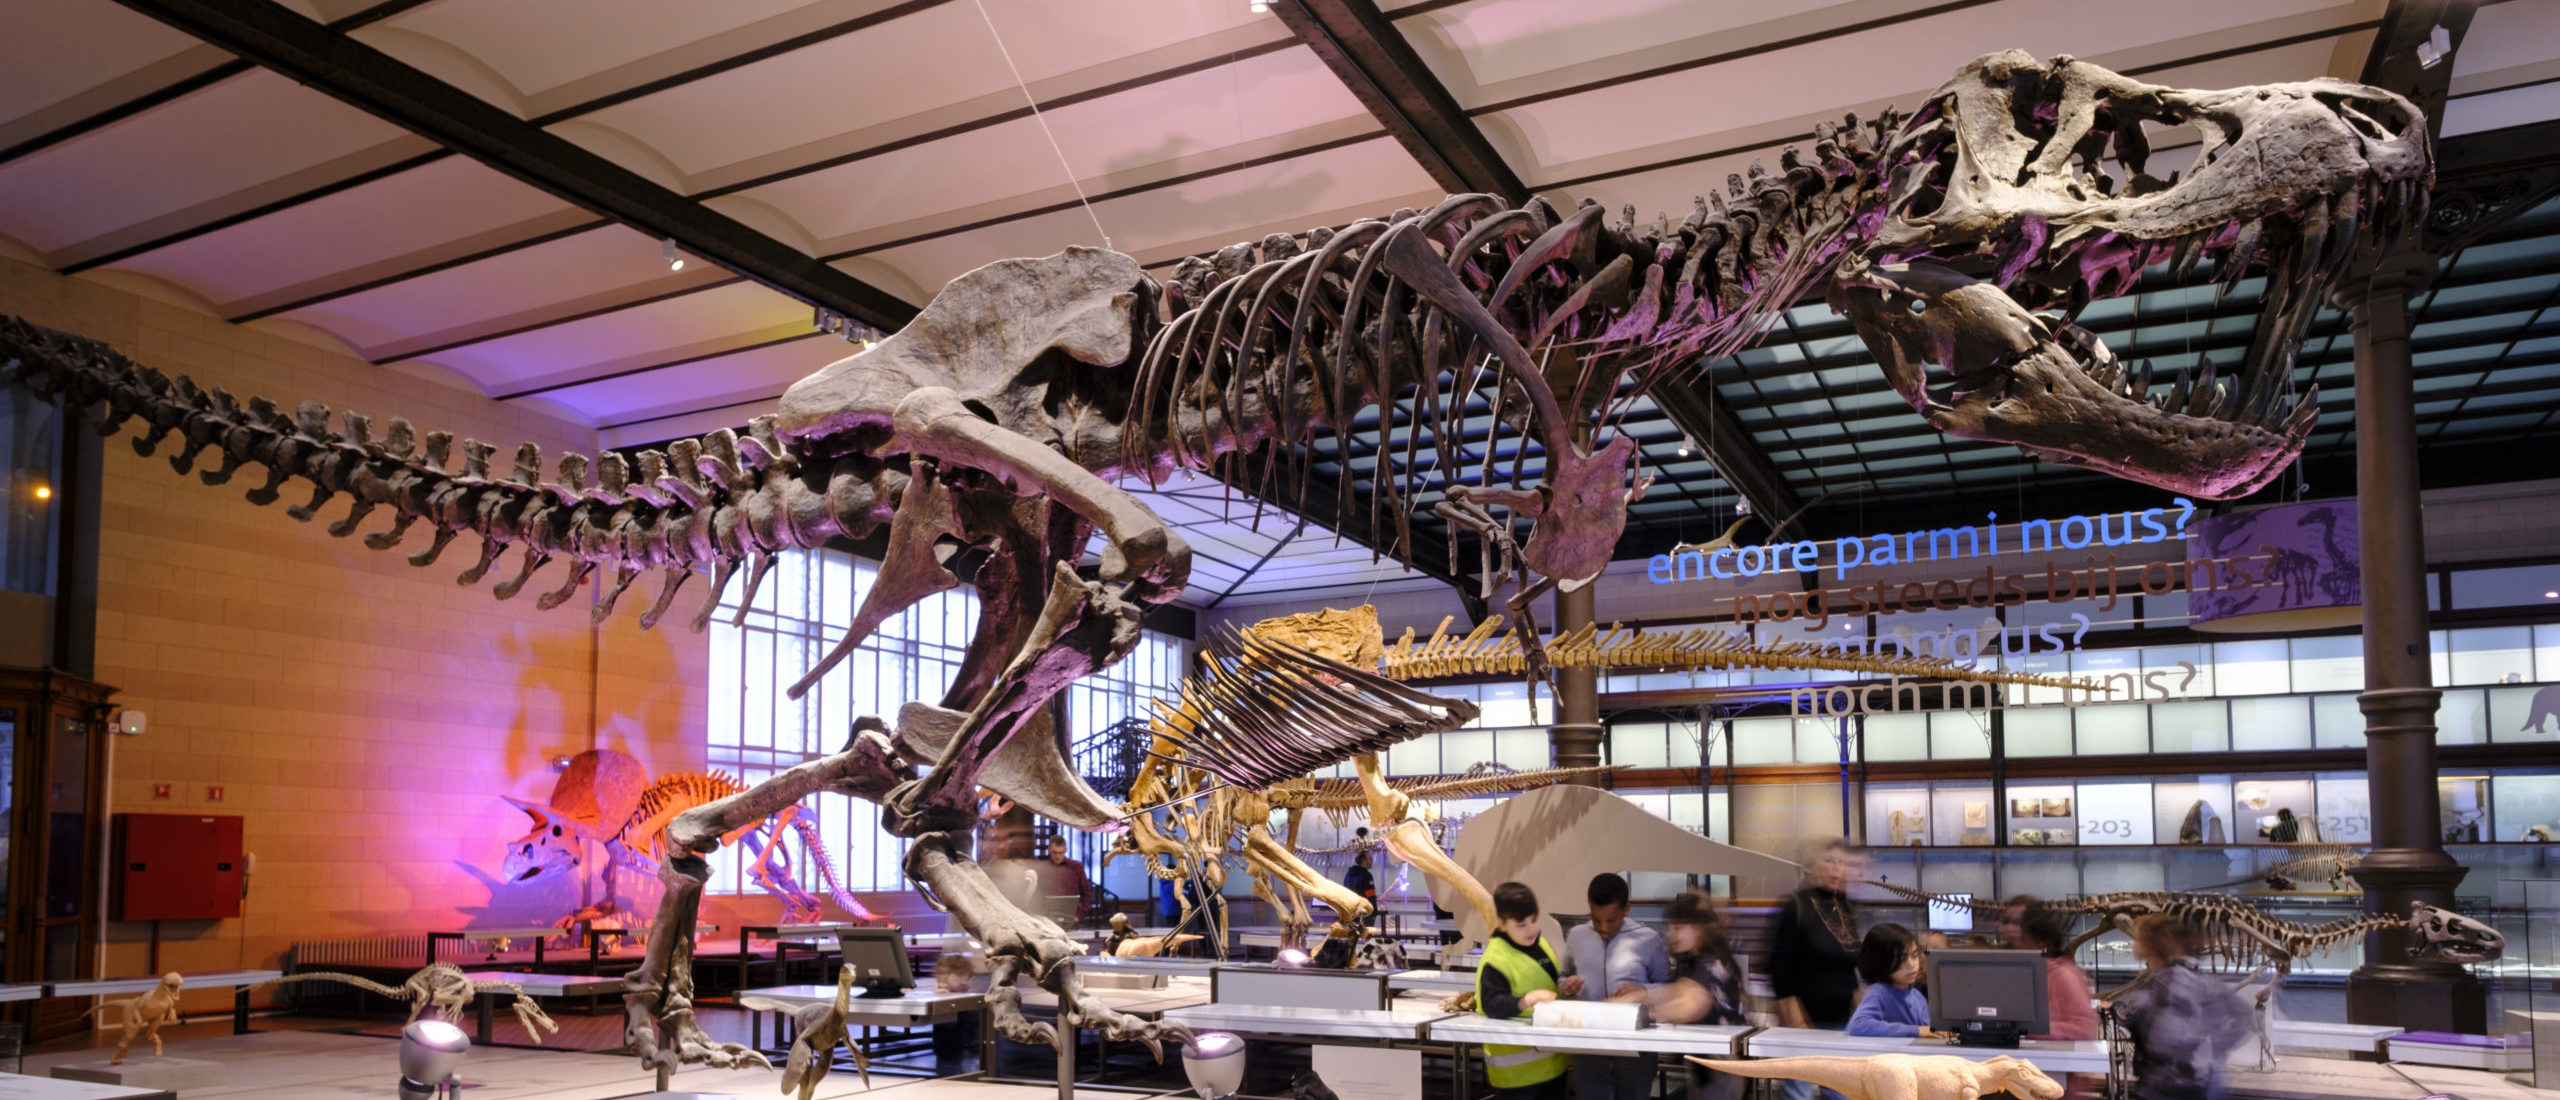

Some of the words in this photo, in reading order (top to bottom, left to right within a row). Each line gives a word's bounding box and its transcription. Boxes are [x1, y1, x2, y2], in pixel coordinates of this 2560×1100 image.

[1648, 539, 1819, 585] encore
[1836, 510, 1998, 581] parmi
[2021, 497, 2194, 553] nous?
[1733, 589, 1829, 632] nog
[1847, 565, 2028, 617] steeds
[2047, 554, 2117, 612] bij
[2141, 546, 2281, 597] ons?
[1796, 626, 1979, 672] mong
[2001, 612, 2091, 659] us?
[1790, 676, 1921, 719] noch
[2062, 660, 2196, 709] uns?
